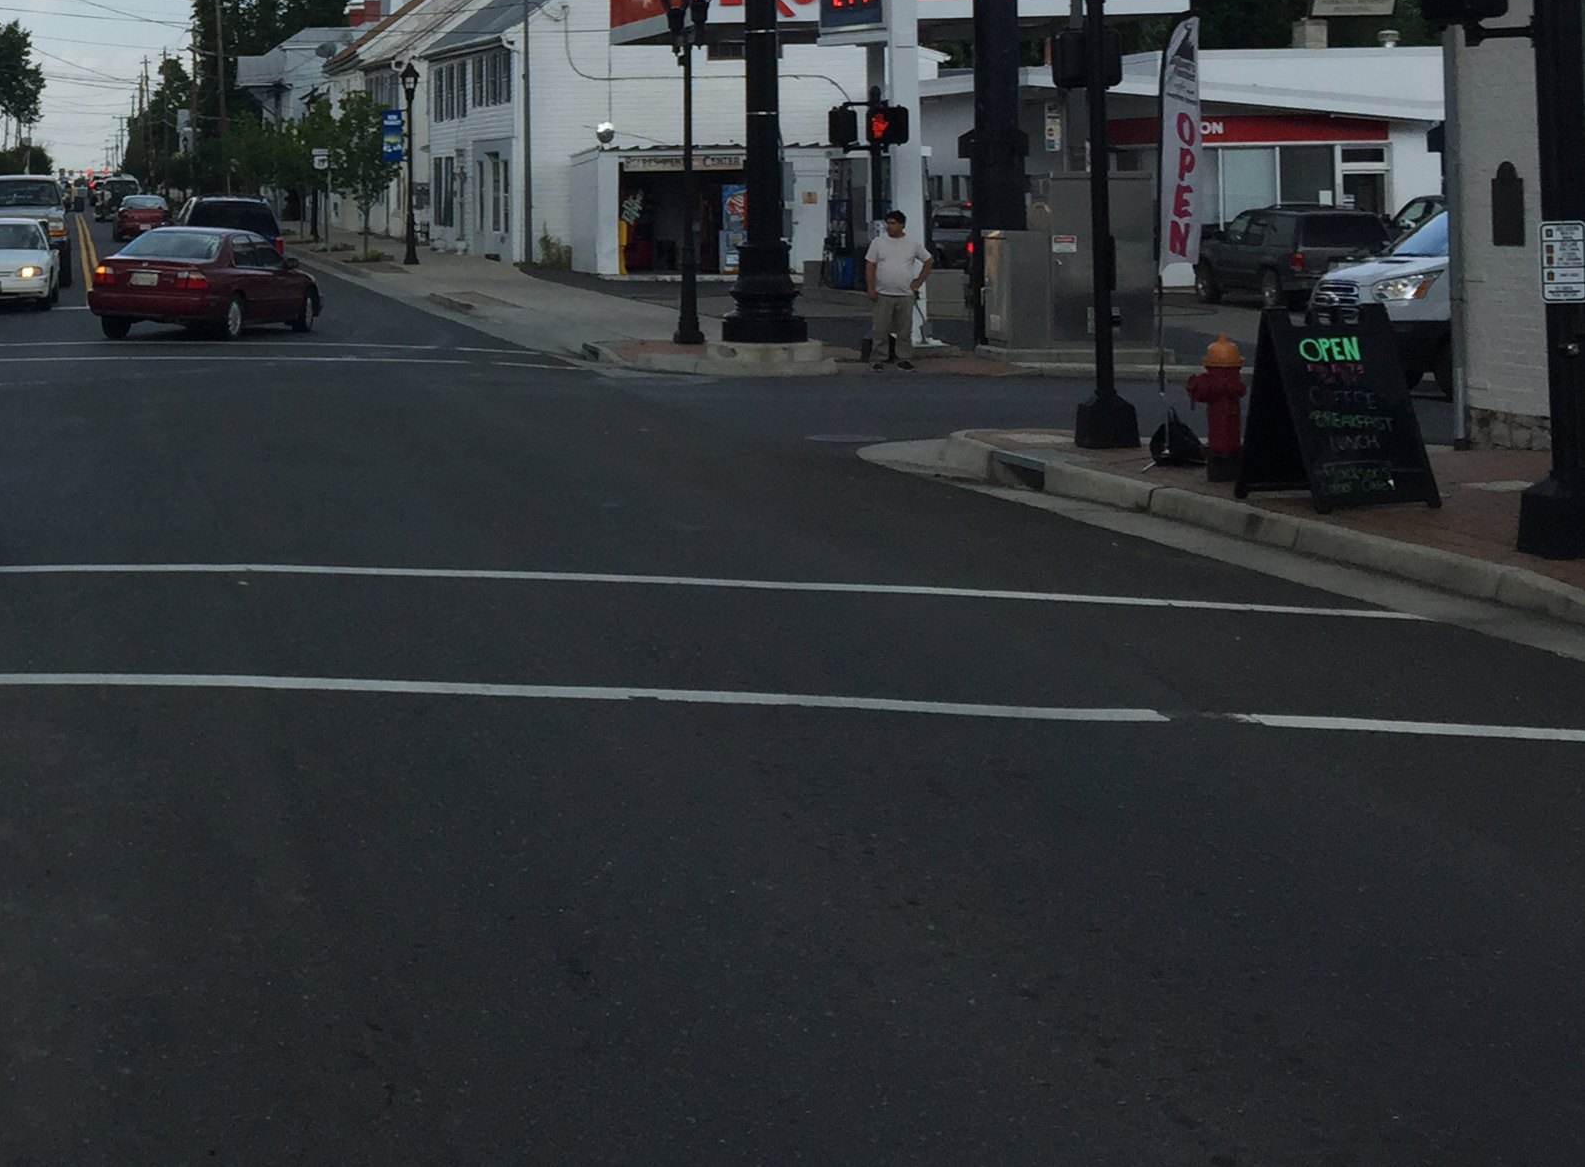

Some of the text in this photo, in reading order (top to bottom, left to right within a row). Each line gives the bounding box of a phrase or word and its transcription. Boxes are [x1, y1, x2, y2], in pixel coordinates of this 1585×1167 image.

[703, 156, 741, 168] CENTER
[1169, 111, 1196, 258] OPEN
[1299, 336, 1362, 362] OPEN
